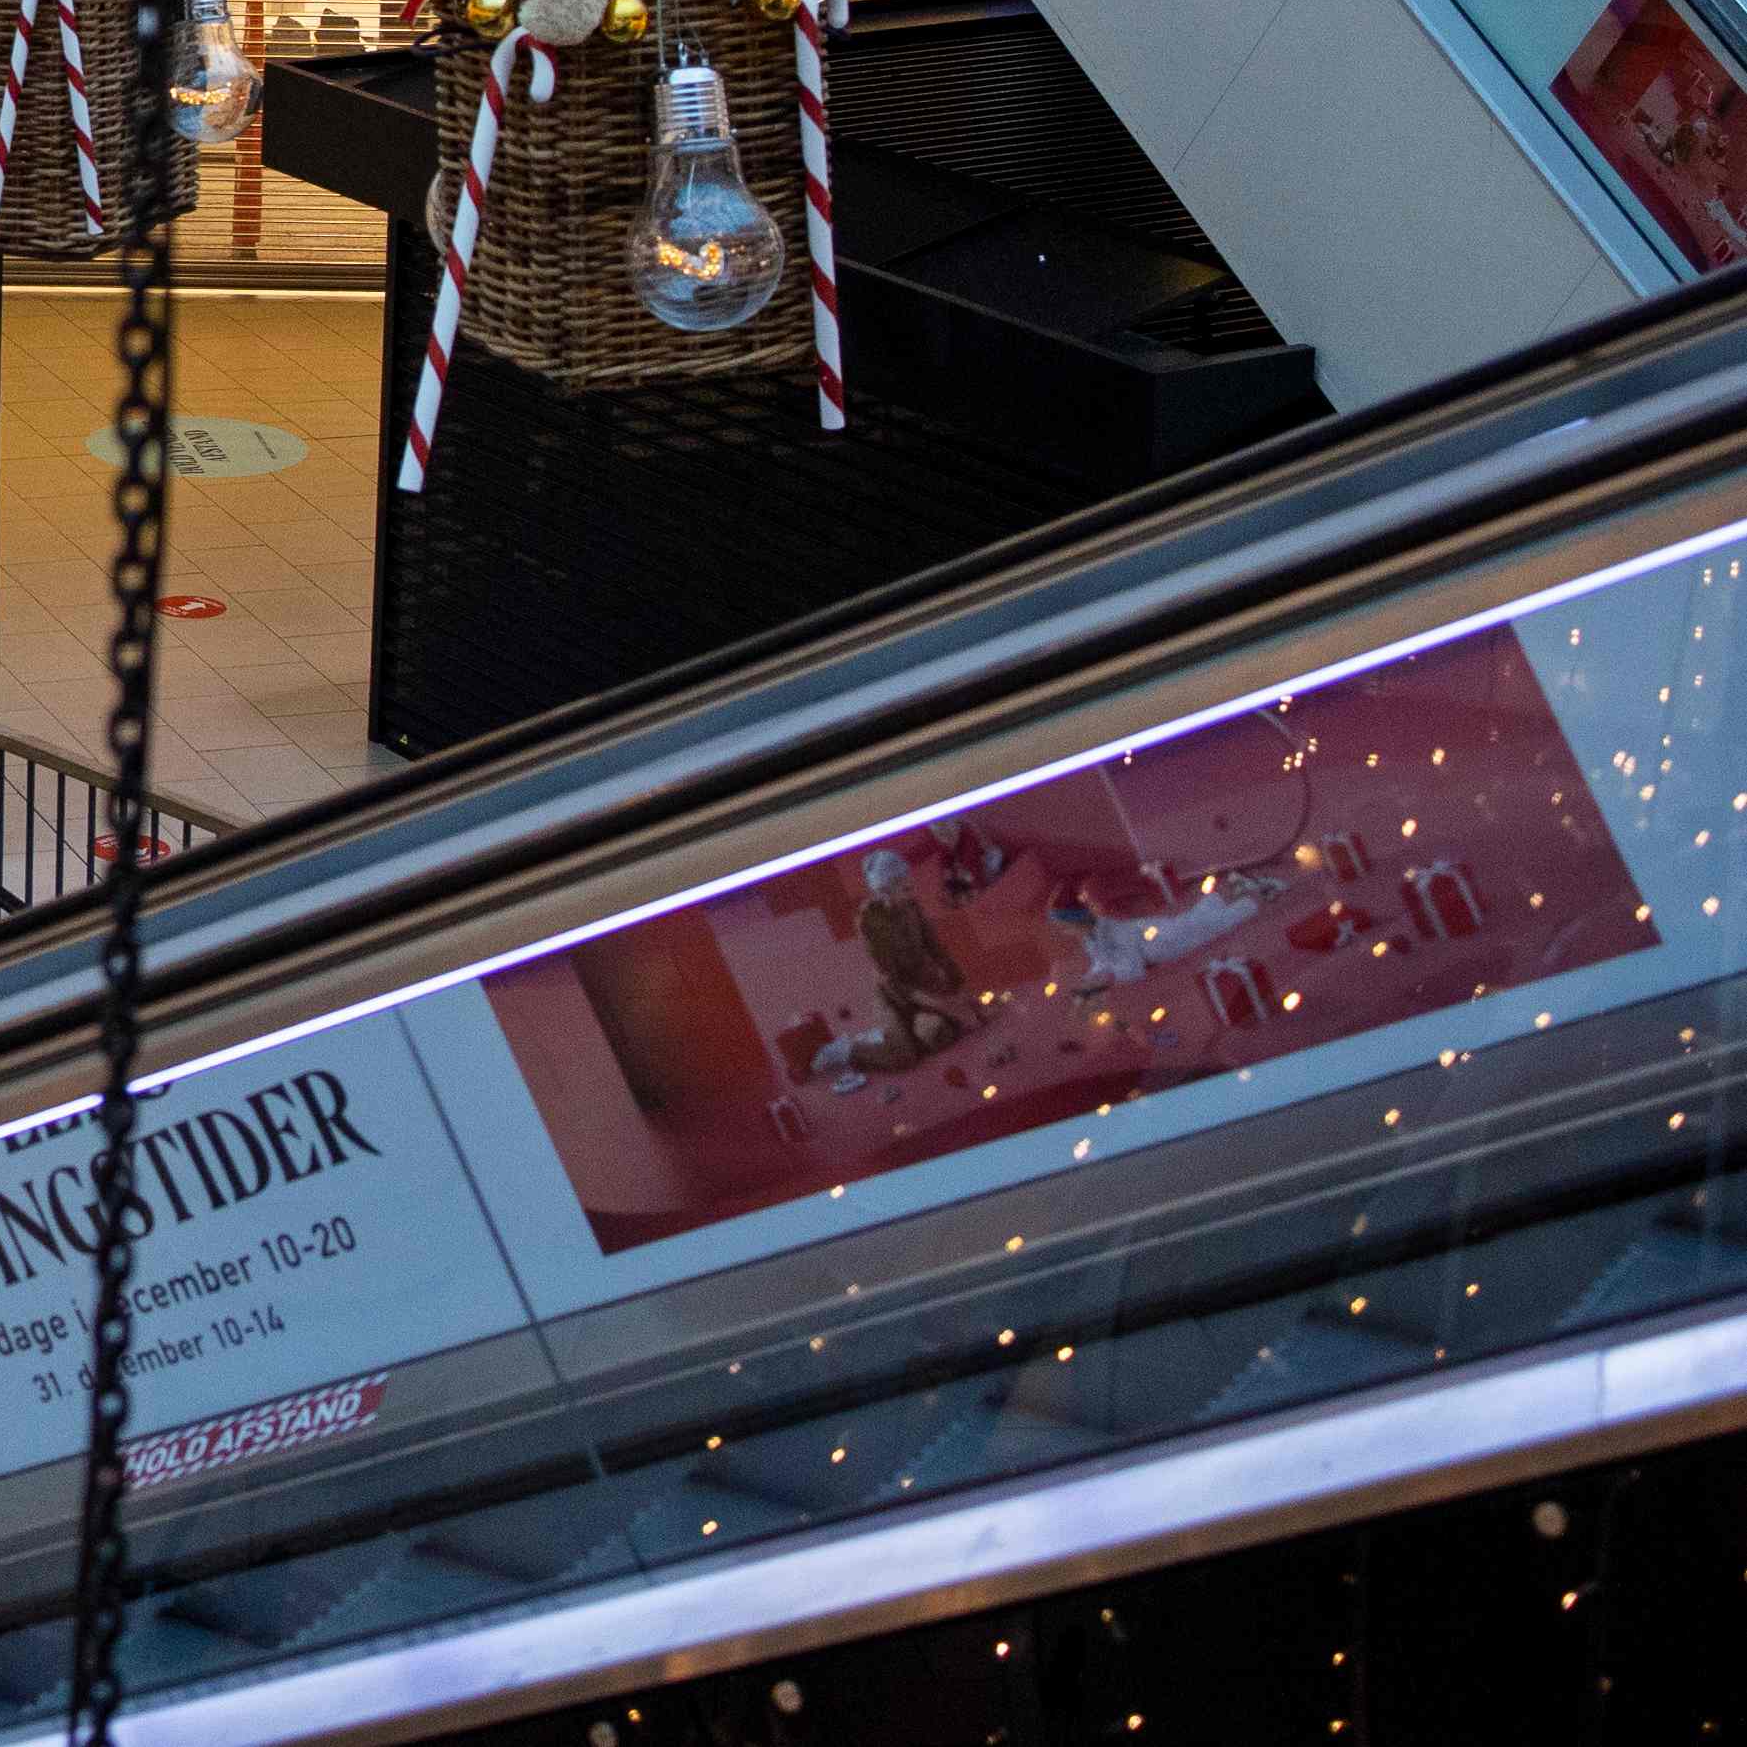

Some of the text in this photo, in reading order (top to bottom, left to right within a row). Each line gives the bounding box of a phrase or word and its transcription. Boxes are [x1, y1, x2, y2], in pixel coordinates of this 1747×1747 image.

[111, 1253, 252, 1319] ecember
[260, 1214, 358, 1277] 10-20
[32, 1304, 286, 1405] 31. dember 10-14
[125, 1388, 363, 1483] HOLD AFSTAND
